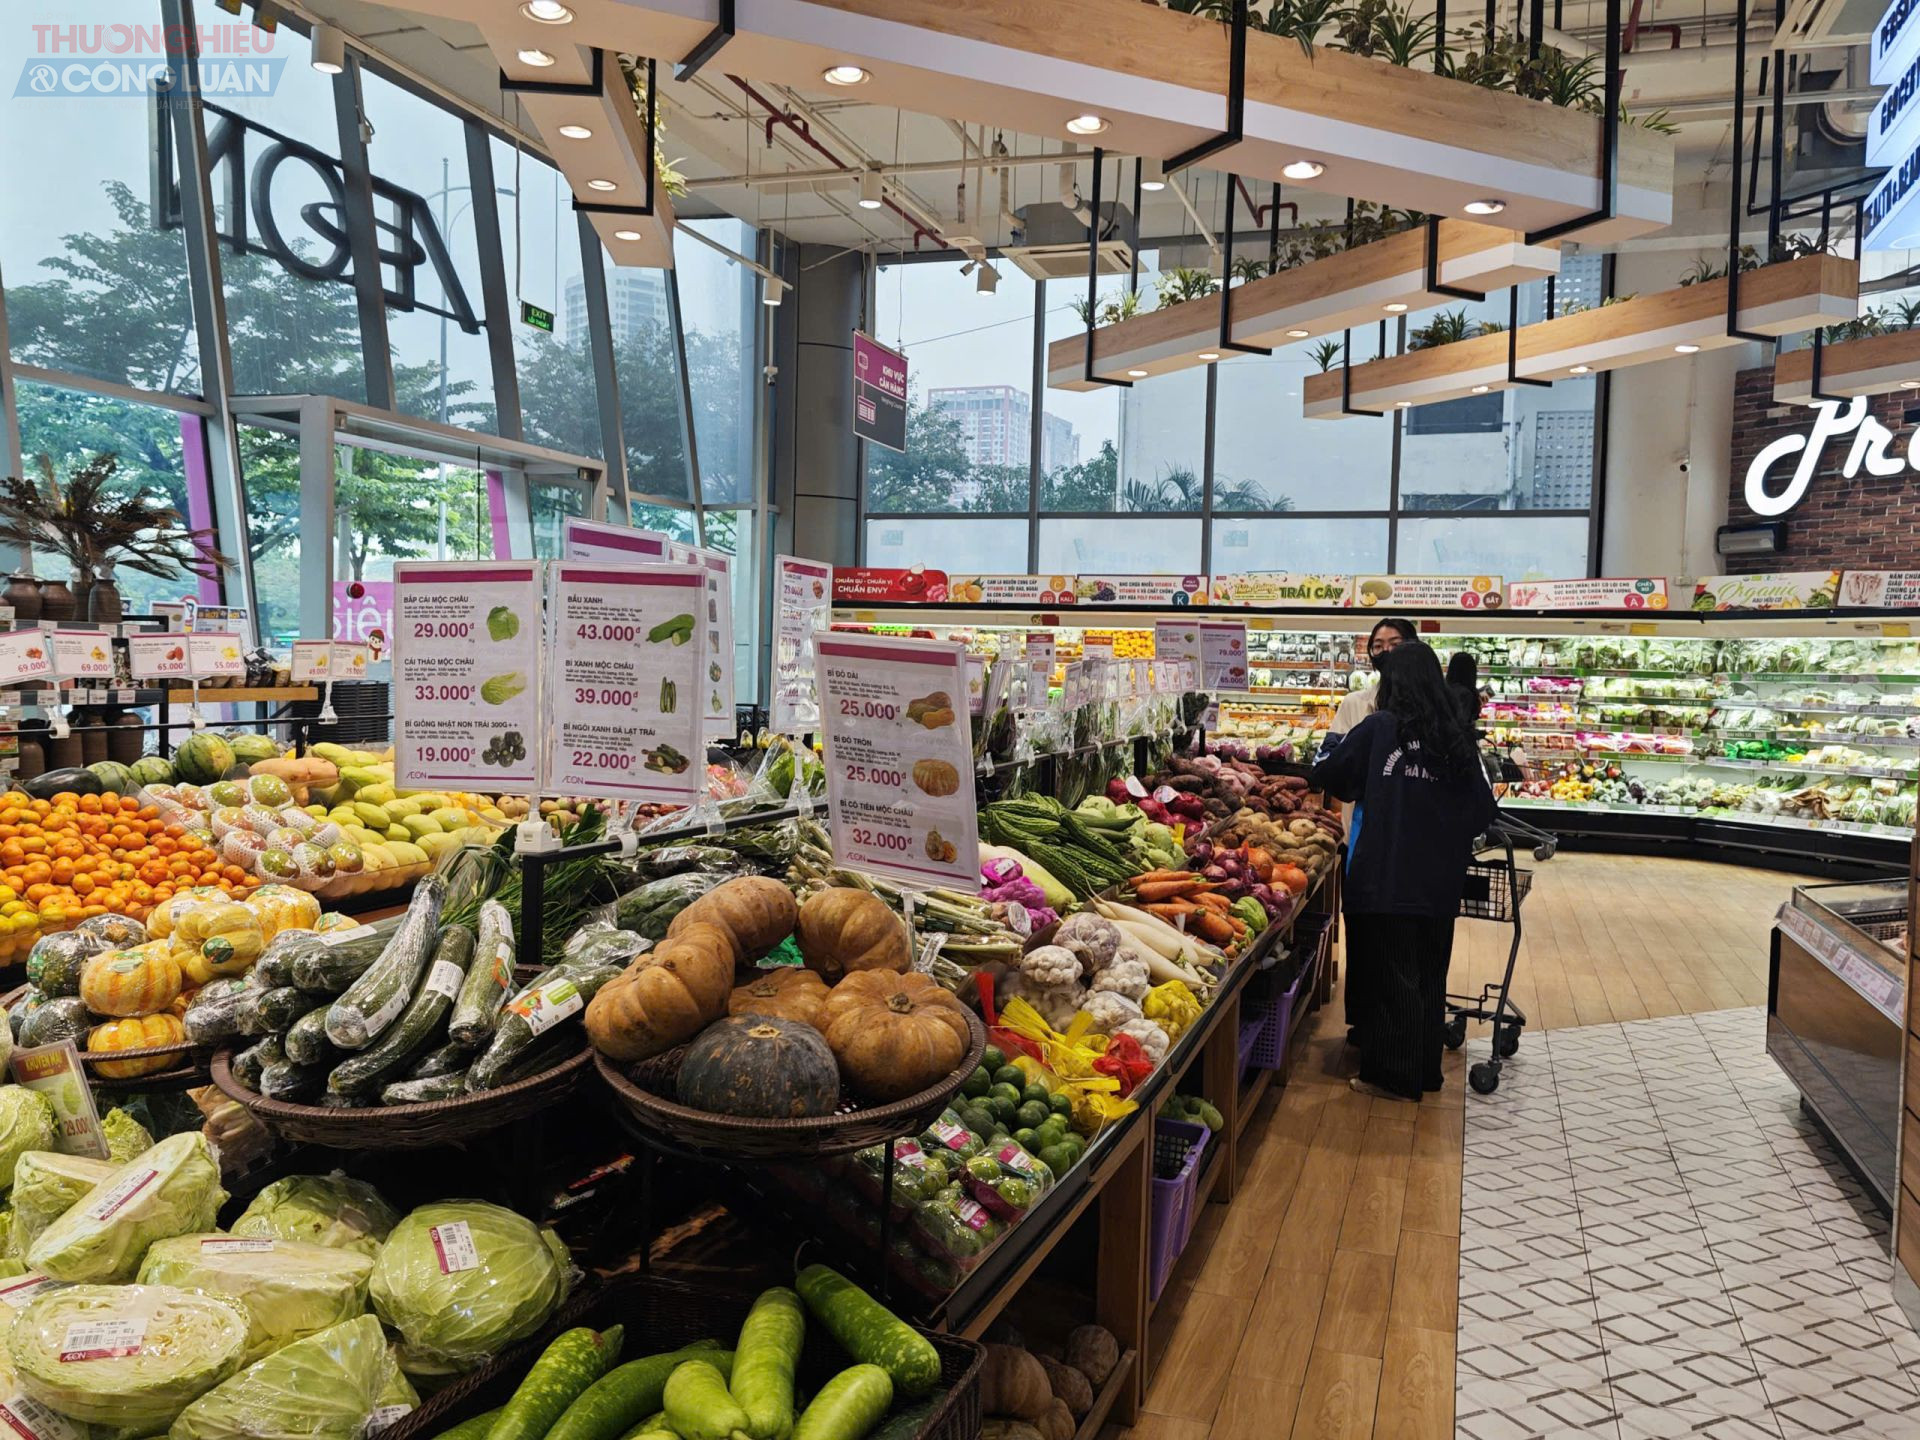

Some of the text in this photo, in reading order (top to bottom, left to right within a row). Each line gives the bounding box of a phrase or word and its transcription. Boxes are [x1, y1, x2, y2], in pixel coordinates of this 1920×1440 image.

[838, 584, 889, 594] CHUẨN ENVY
[1280, 584, 1344, 599] TRÁI CÂY
[1717, 580, 1798, 604] Organic
[432, 595, 448, 604] MỘC
[450, 595, 468, 603] CHÂU
[1630, 597, 1638, 606] A
[438, 658, 454, 666] MỘC
[595, 660, 612, 670] MỘC
[614, 661, 634, 670] CHÂU
[438, 720, 456, 729] NHẬT
[474, 720, 490, 728] TRÁI
[624, 727, 637, 737] LẠT
[638, 727, 656, 736] TRÁI
[1383, 747, 1403, 776] TRƯỜN
[876, 803, 892, 814] MỘC
[894, 806, 914, 817] CHÂU
